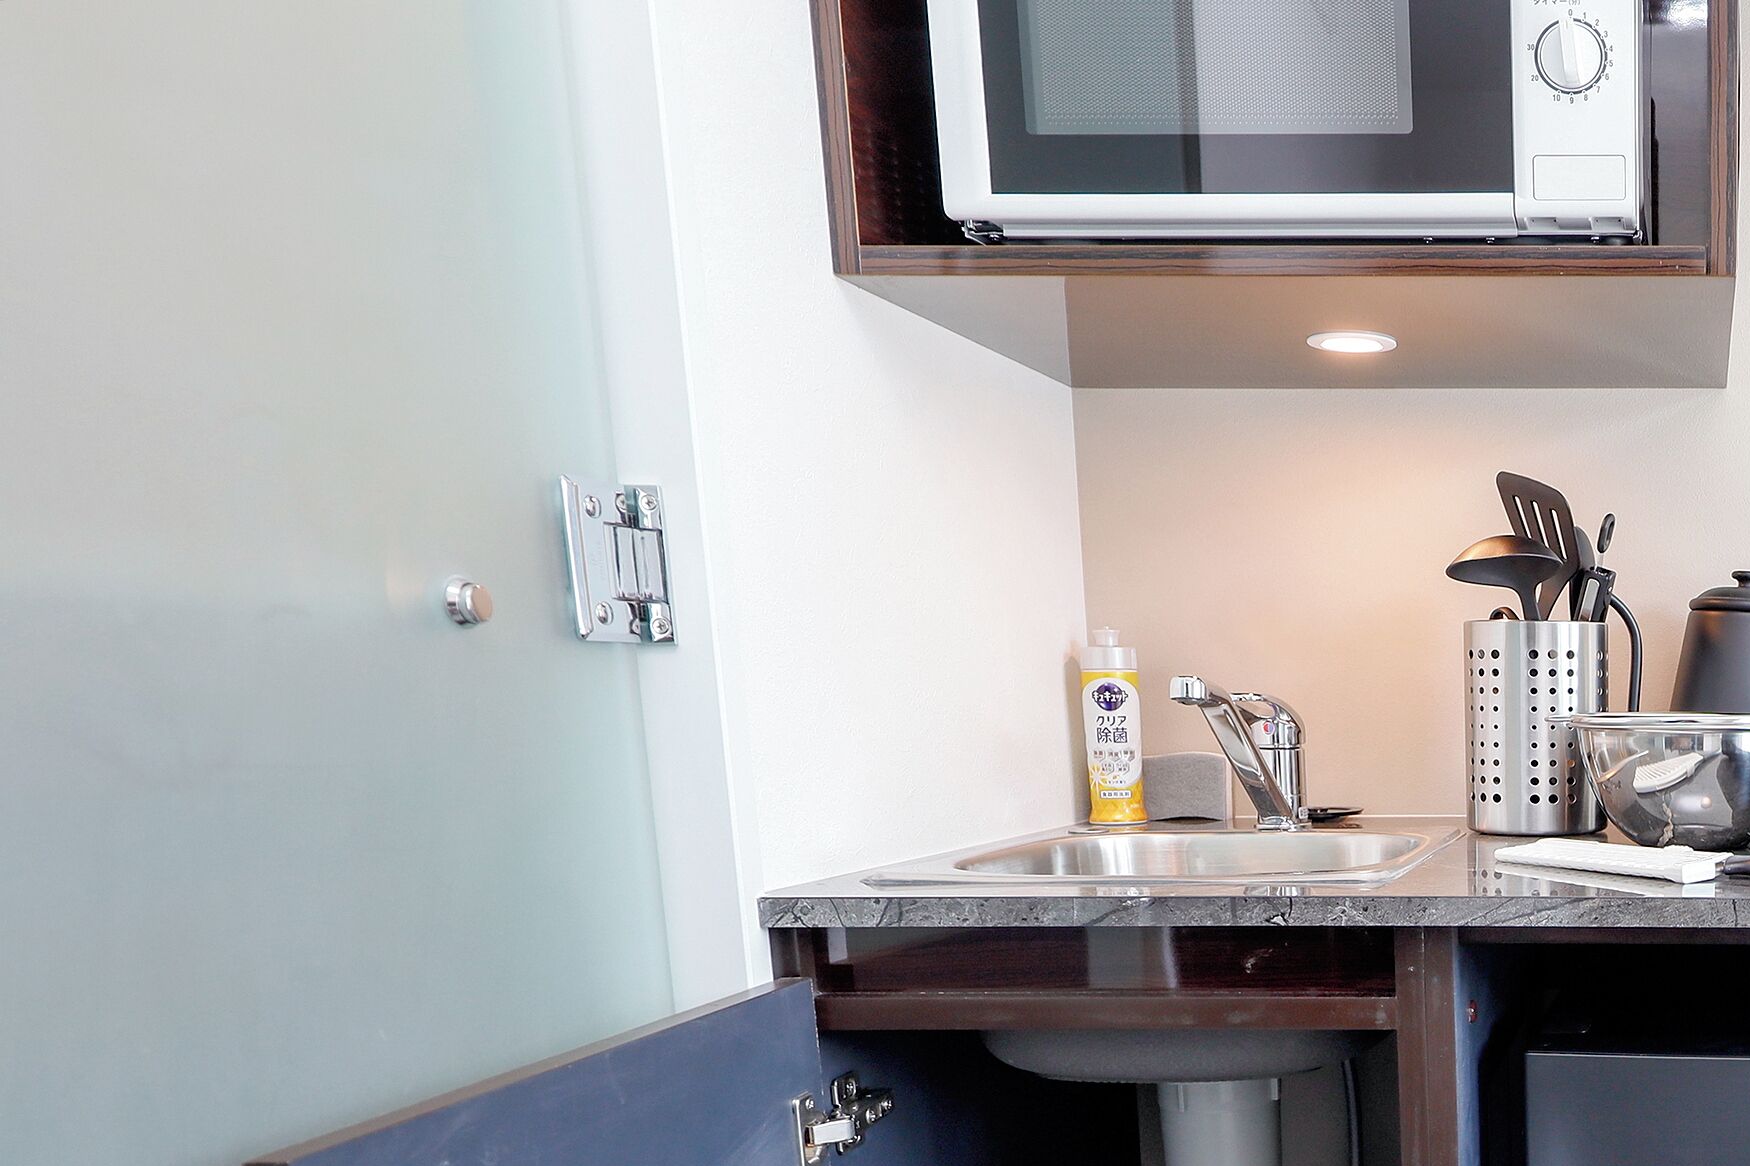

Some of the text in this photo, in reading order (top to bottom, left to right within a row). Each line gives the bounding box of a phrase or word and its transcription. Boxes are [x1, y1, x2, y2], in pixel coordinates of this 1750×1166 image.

[1605, 73, 1610, 81] 6
[1092, 690, 1129, 702] キュキュット
[1096, 715, 1127, 727] クリア
[1096, 727, 1128, 744] 除菌
